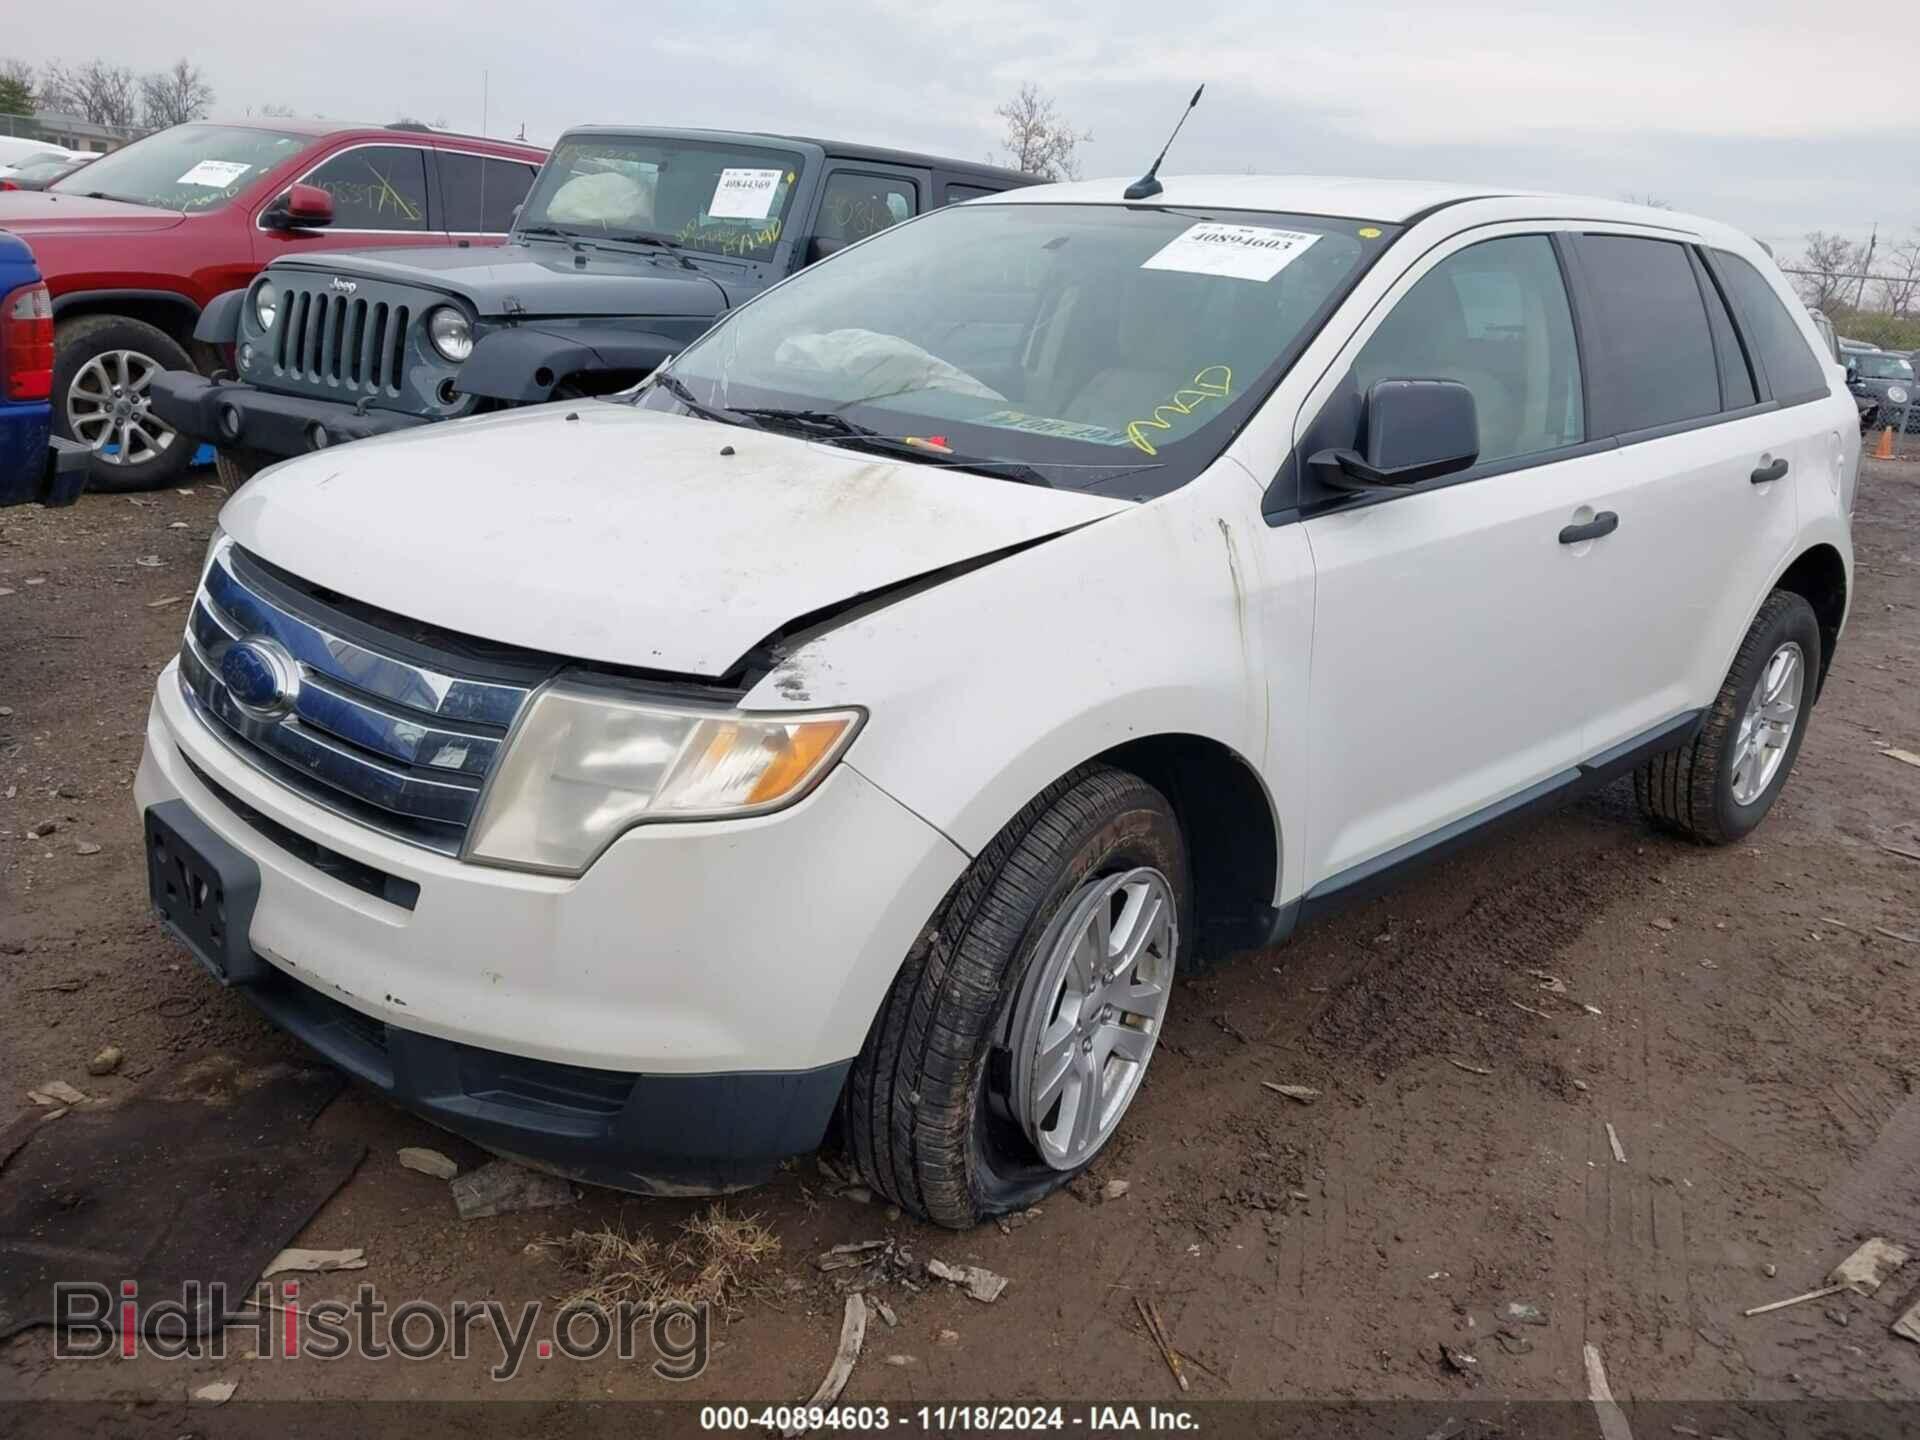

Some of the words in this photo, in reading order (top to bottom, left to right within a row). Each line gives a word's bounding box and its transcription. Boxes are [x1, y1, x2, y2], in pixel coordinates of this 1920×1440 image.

[724, 179, 771, 189] 40844369
[1192, 231, 1294, 251] 40894603
[329, 277, 357, 294] Jeep
